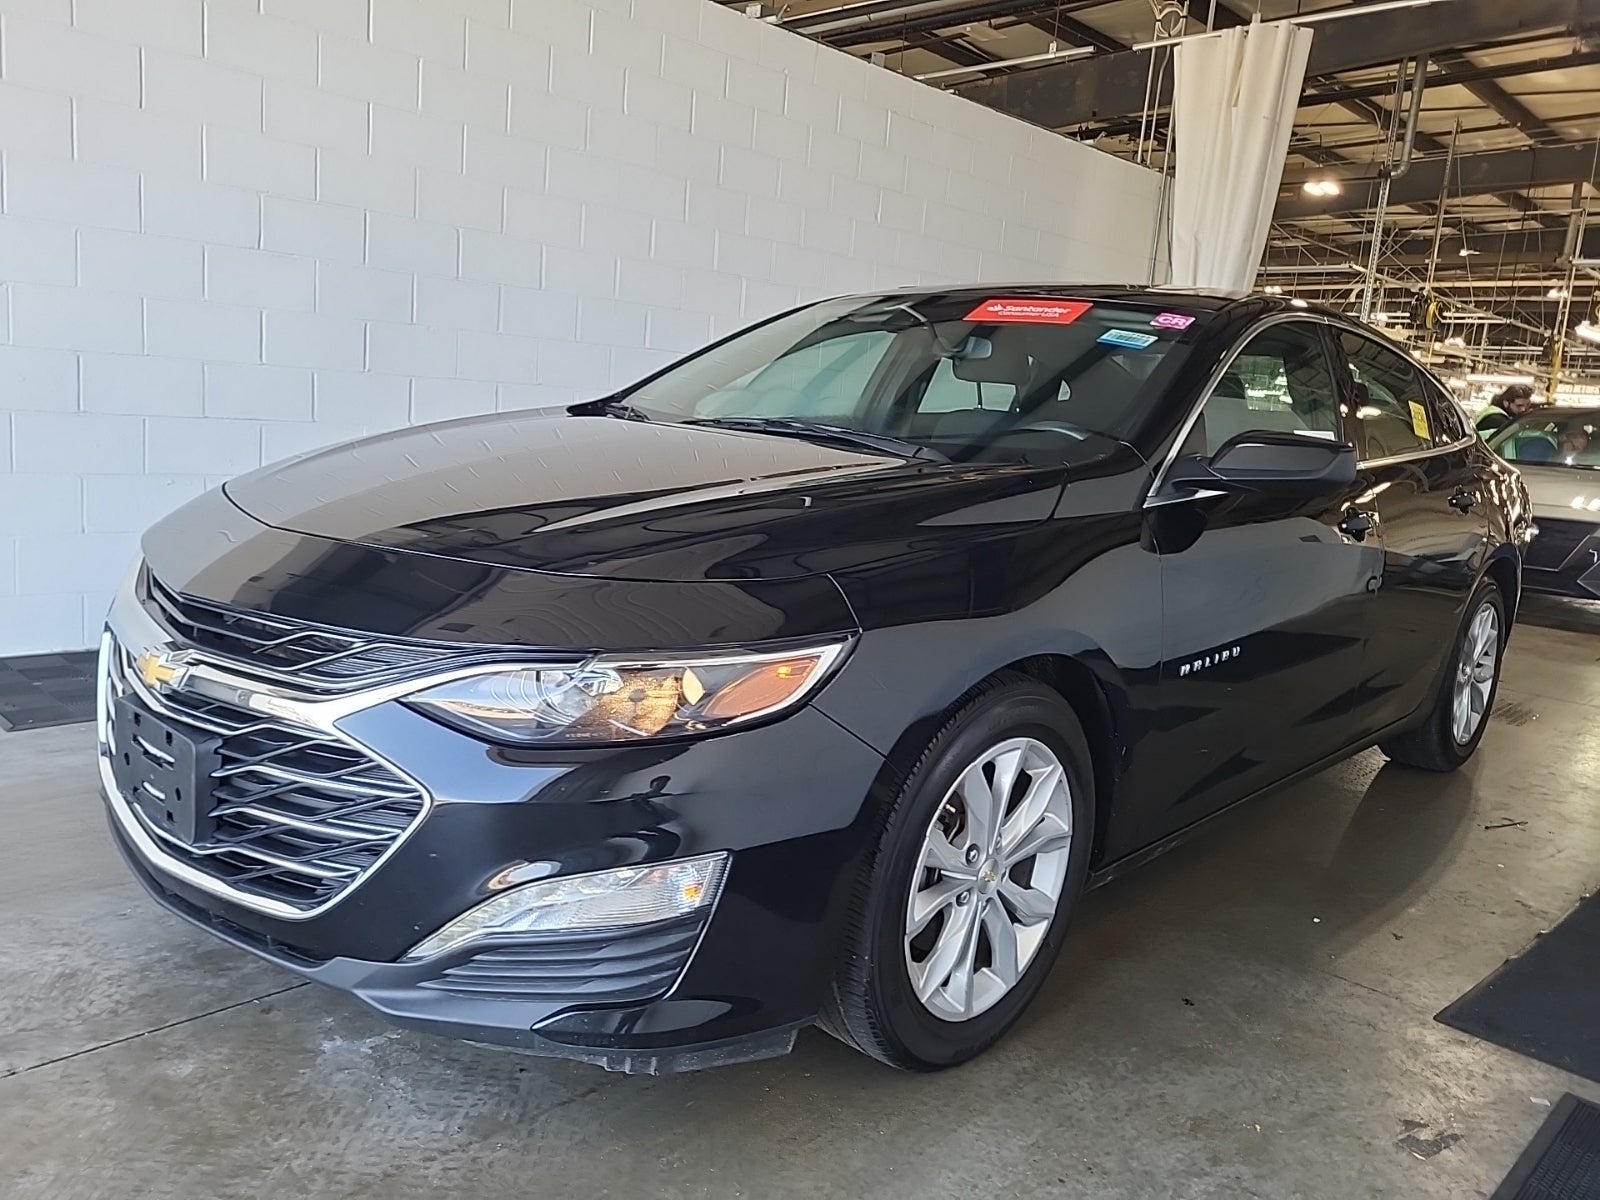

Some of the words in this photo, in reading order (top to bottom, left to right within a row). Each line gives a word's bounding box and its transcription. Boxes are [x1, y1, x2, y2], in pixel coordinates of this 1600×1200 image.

[1004, 305, 1072, 314] Santander
[1158, 316, 1187, 326] CR
[1179, 646, 1241, 677] MALIBU
